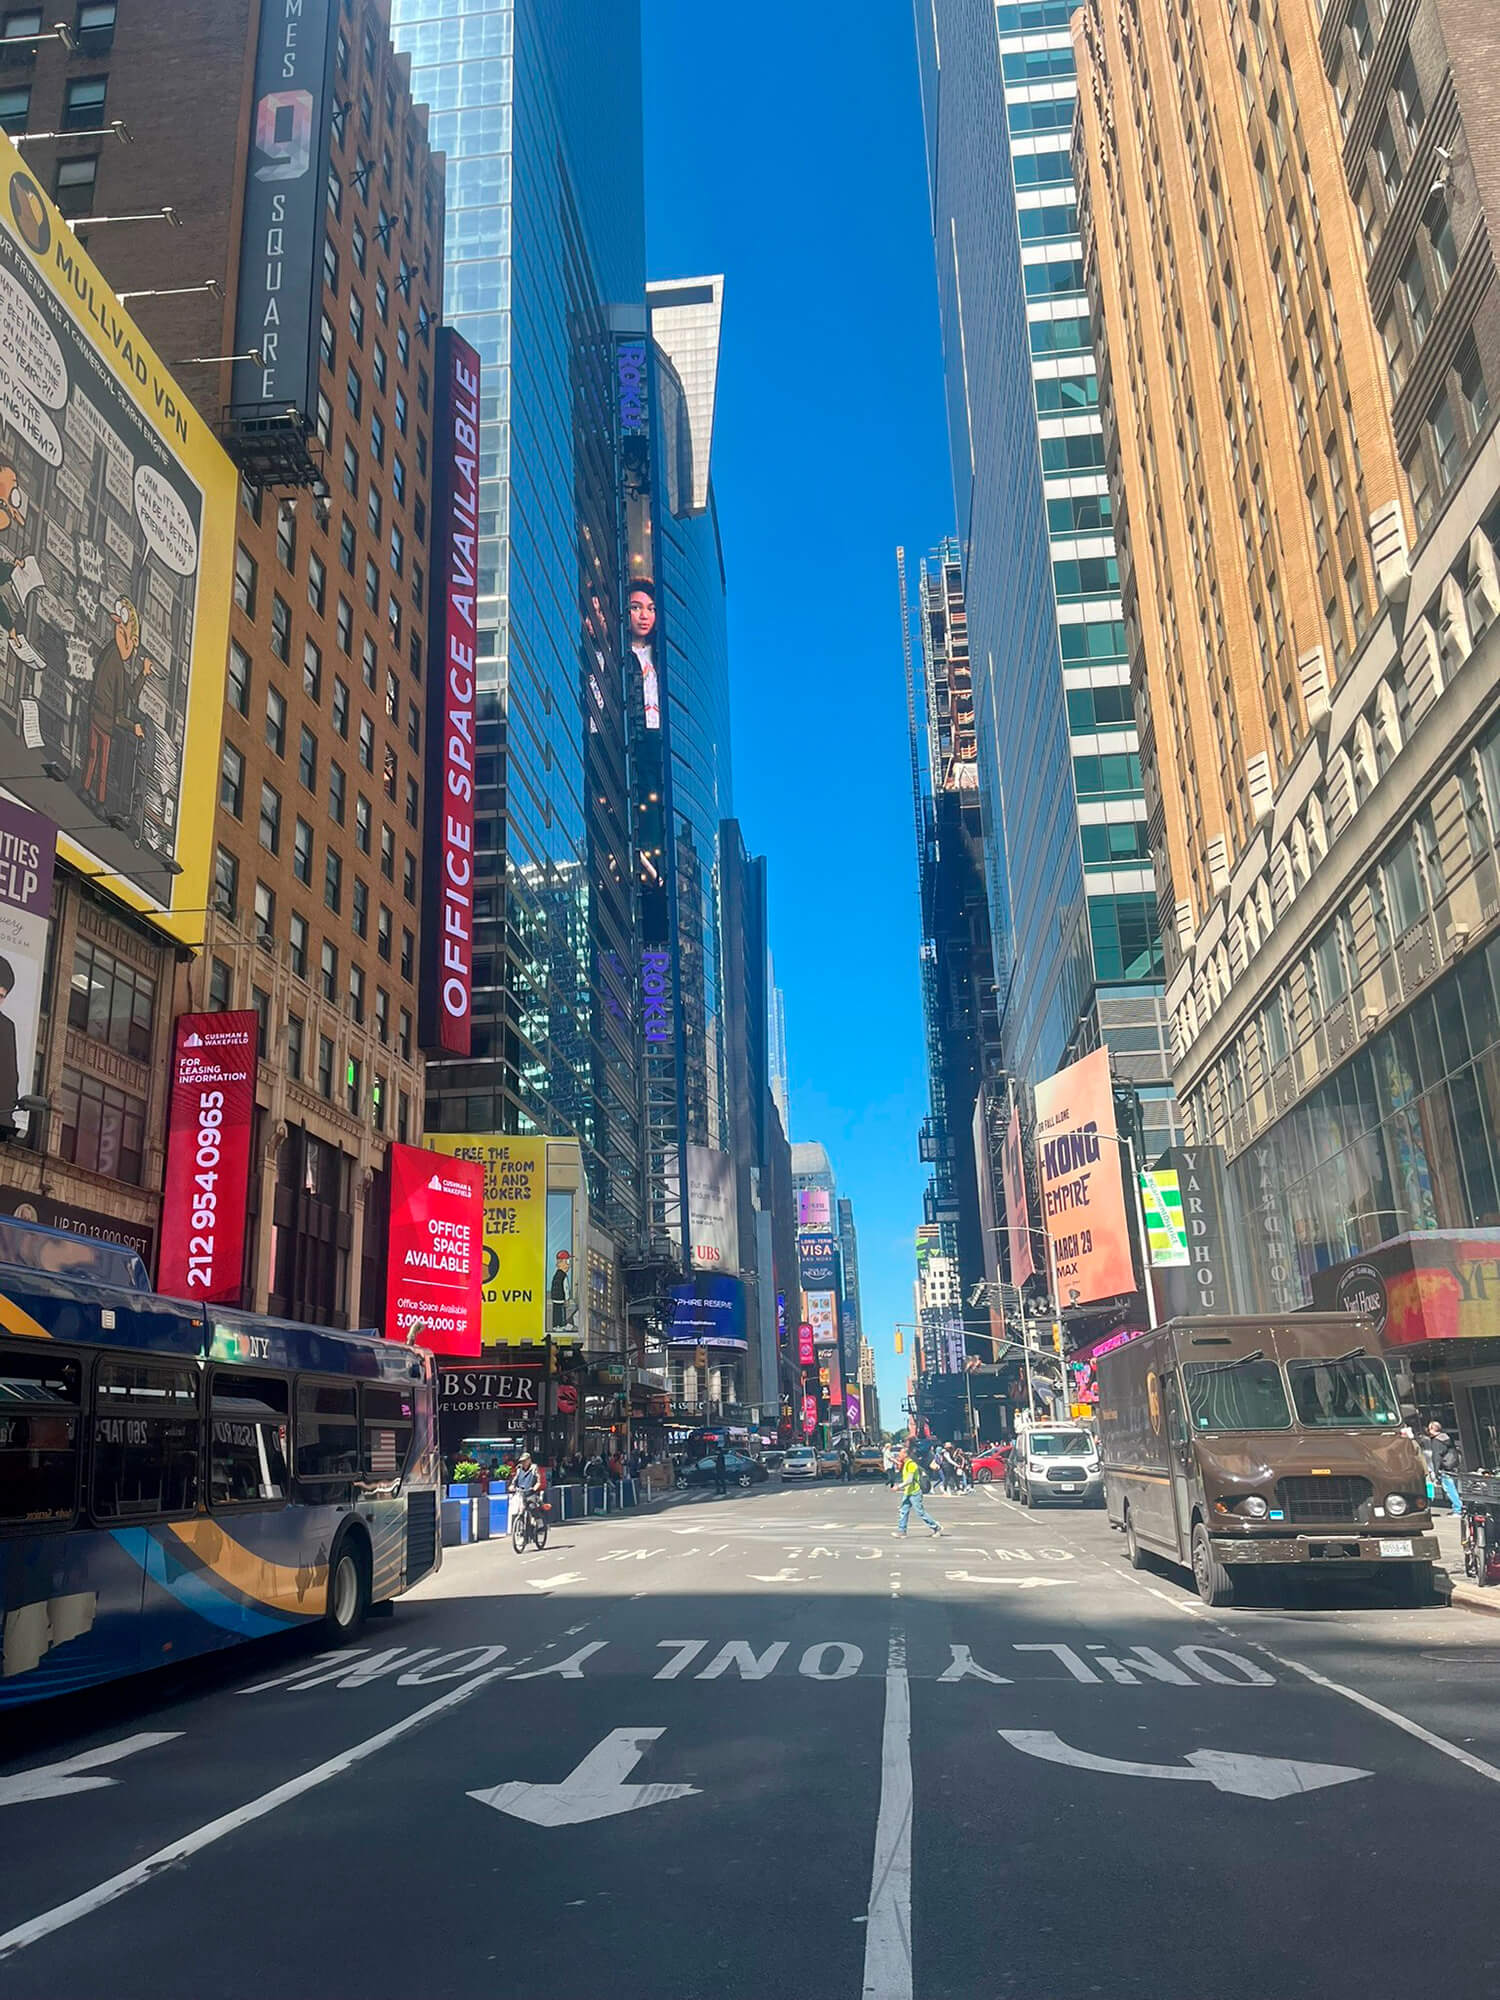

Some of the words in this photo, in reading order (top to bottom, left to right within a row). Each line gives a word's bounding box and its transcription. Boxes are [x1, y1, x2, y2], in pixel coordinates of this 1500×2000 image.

[254, 88, 314, 183] 9
[262, 194, 286, 399] SQUARE
[25, 302, 51, 349] THIS?
[14, 249, 44, 304] FRIEND
[47, 292, 62, 327] WAS
[118, 389, 142, 434] SEARCH
[56, 240, 148, 386] MULLVAD
[154, 378, 188, 444] VPN
[450, 357, 479, 630] AVAILABLE
[447, 633, 474, 804] SPACE
[442, 825, 472, 1017] OFFICE
[204, 1032, 242, 1041] CUSHMAN
[204, 1038, 249, 1047] WAKEFIELD
[179, 1065, 221, 1075] LEASING
[180, 1057, 201, 1067] FOR
[178, 1072, 247, 1084] INFORMATION
[195, 1091, 225, 1168] 0965
[1044, 1116, 1055, 1130] FALL
[1055, 1108, 1070, 1125] ALONE
[487, 1147, 510, 1160] THE
[1043, 1120, 1101, 1181] KONG
[501, 1160, 535, 1173] FROM
[501, 1174, 529, 1187] AND
[190, 1170, 219, 1230] 954
[483, 1186, 532, 1200] ROKERS
[1045, 1172, 1092, 1217] EMPIRE
[1182, 1152, 1207, 1236] YARD
[73, 1220, 87, 1234] TO
[428, 1219, 471, 1241] OFFICE
[433, 1238, 470, 1257] SPACE
[696, 1245, 720, 1261] UBS
[801, 1244, 833, 1256] VISA
[1080, 1229, 1093, 1255] 29
[186, 1235, 215, 1288] 212
[404, 1250, 470, 1274] AVAILABLE
[1193, 1246, 1215, 1308] HOU
[397, 1298, 418, 1310] Office
[419, 1301, 438, 1313] Space
[439, 1303, 468, 1315] Available
[502, 1290, 533, 1303] VPN
[456, 1319, 468, 1332] SF
[249, 1335, 270, 1359] NY
[452, 1401, 500, 1412] LOBSTER
[506, 1640, 865, 1682] ONLY
[935, 1643, 1278, 1687] ONLY
